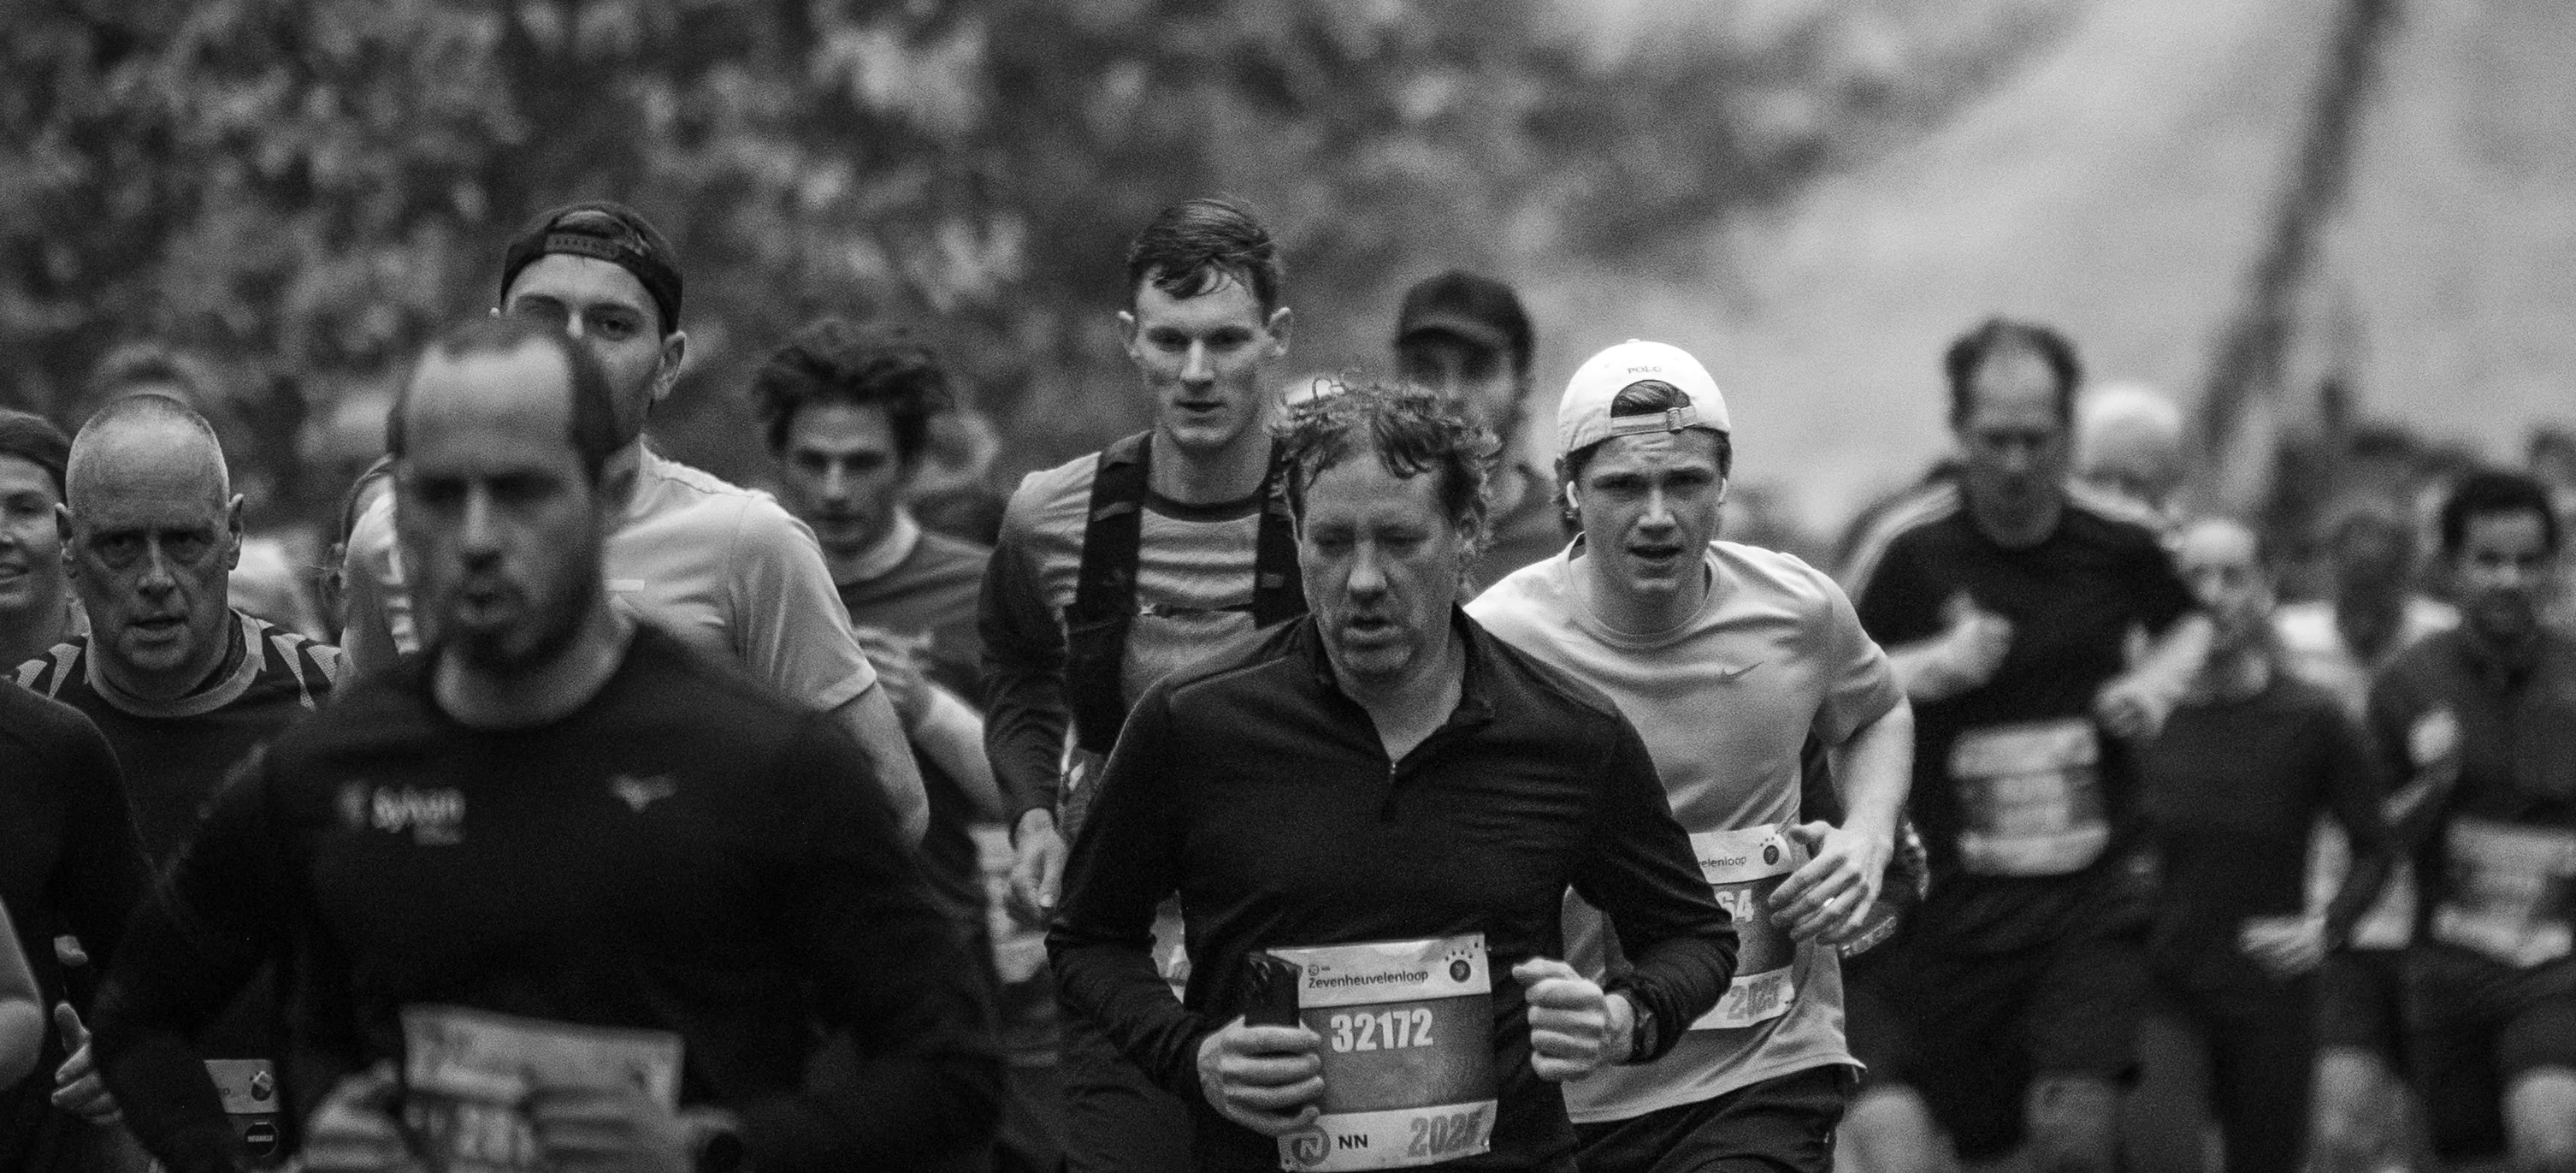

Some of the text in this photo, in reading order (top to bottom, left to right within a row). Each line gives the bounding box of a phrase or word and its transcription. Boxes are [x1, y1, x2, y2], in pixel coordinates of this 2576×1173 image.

[1627, 365, 1662, 374] POLO
[1309, 969, 1429, 989] Zevenheuvelenloop
[1331, 1009, 1434, 1053] 32172
[1338, 1134, 1368, 1150] NN
